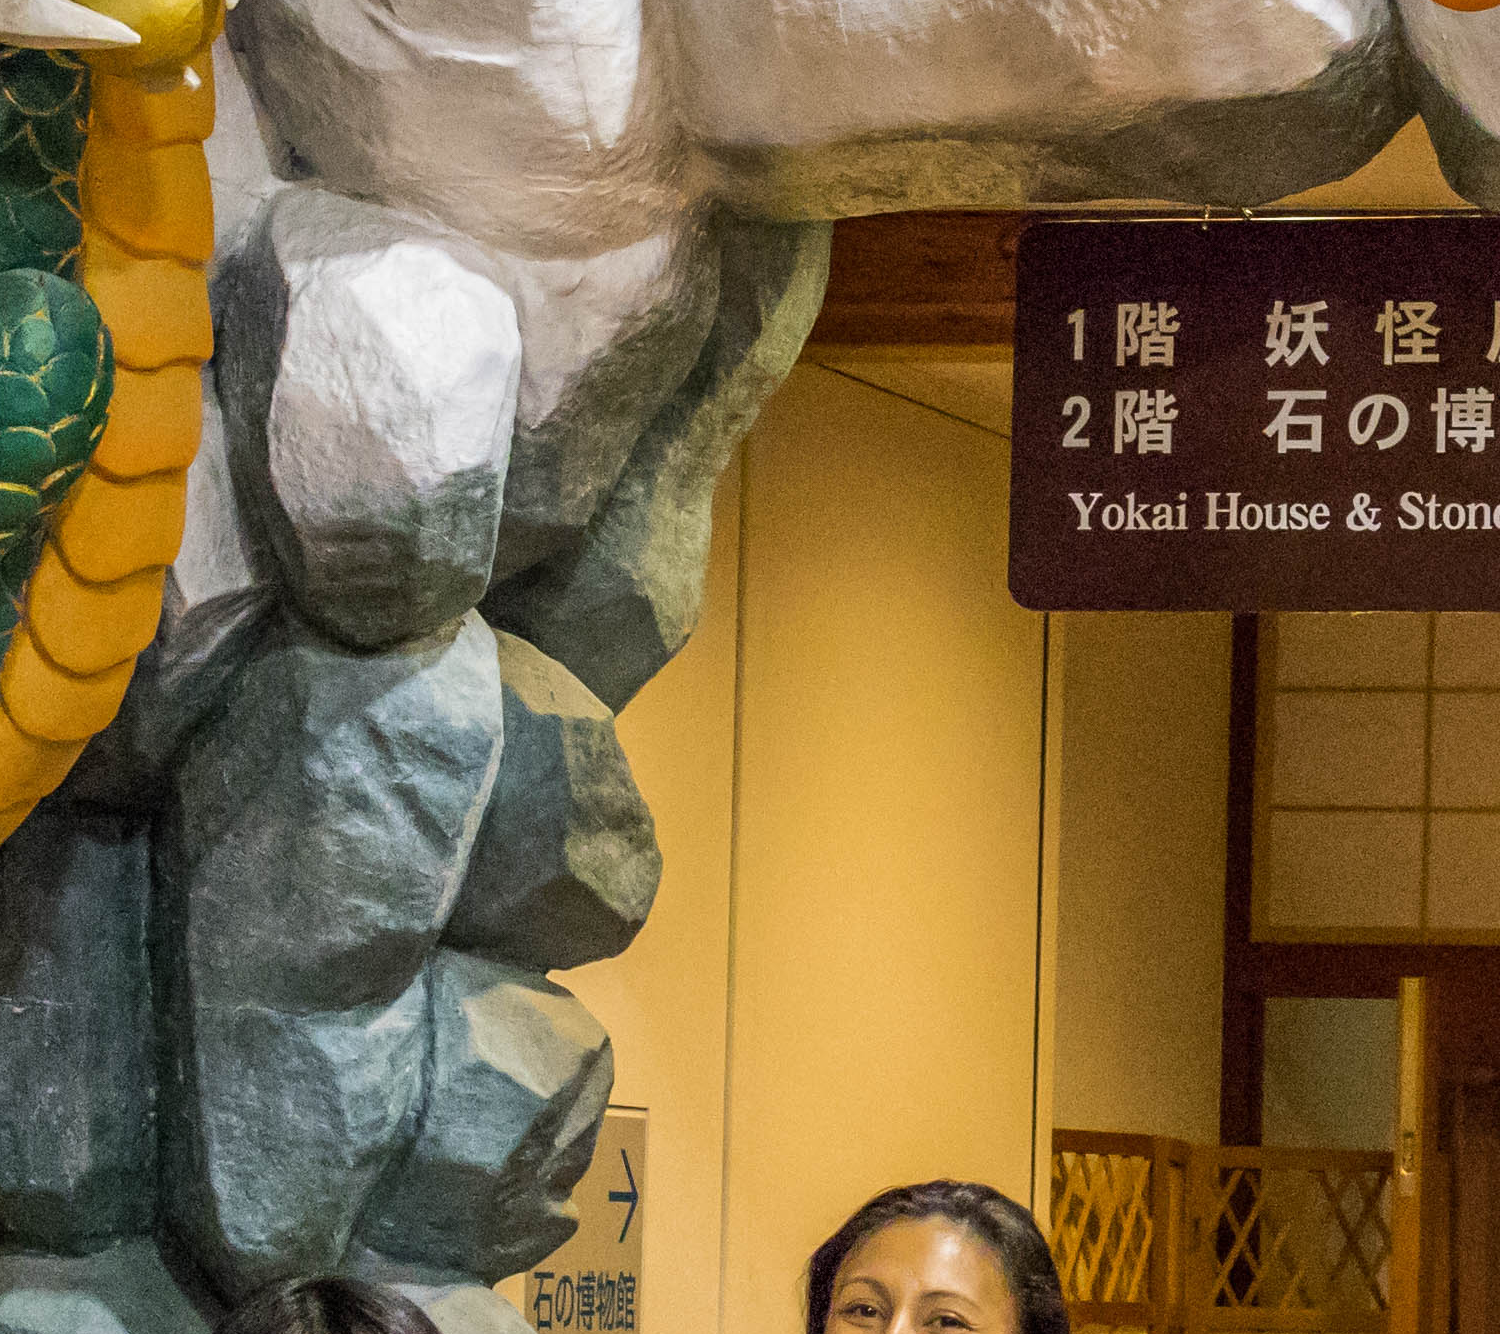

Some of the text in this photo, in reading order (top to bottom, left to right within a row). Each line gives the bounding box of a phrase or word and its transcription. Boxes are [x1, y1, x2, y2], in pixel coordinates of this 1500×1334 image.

[1065, 301, 1182, 368] 1階
[1063, 390, 1178, 455] 2階
[1068, 492, 1189, 534] Yokai
[1204, 492, 1330, 533] House
[1346, 494, 1382, 533] &
[533, 1270, 636, 1331] 石の博物館
